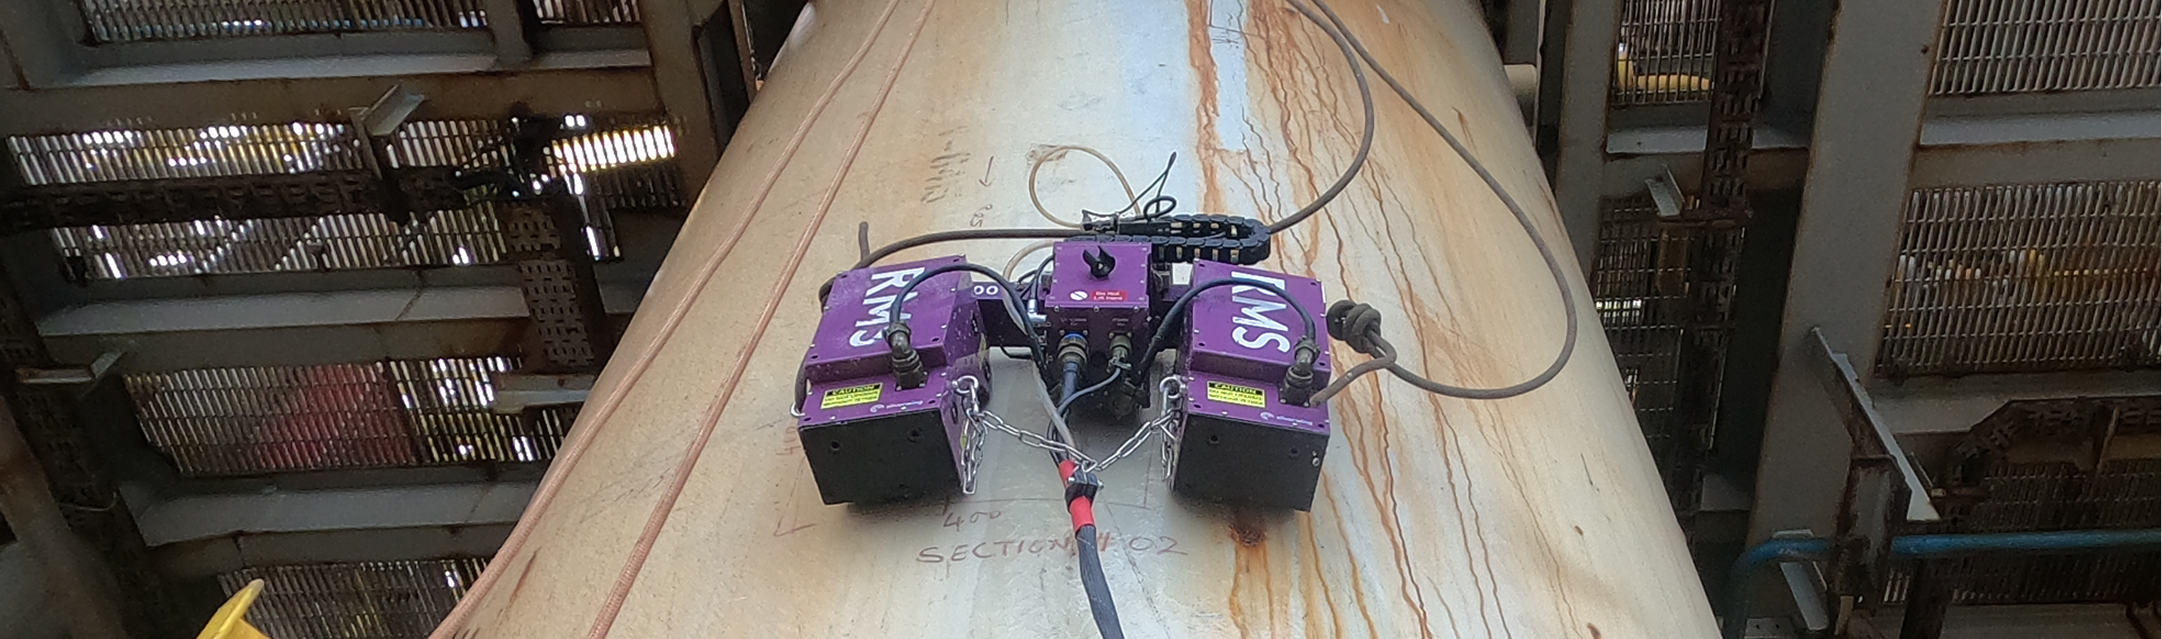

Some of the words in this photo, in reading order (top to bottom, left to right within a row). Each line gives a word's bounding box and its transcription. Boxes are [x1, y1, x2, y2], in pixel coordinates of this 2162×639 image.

[849, 267, 926, 347] RMS
[1231, 271, 1291, 353] RMS
[832, 384, 875, 396] CAUTION
[1214, 382, 1257, 394] CAUTION
[943, 510, 1002, 532] 400
[915, 530, 1075, 563] SECTION
[1128, 536, 1188, 556] 02
